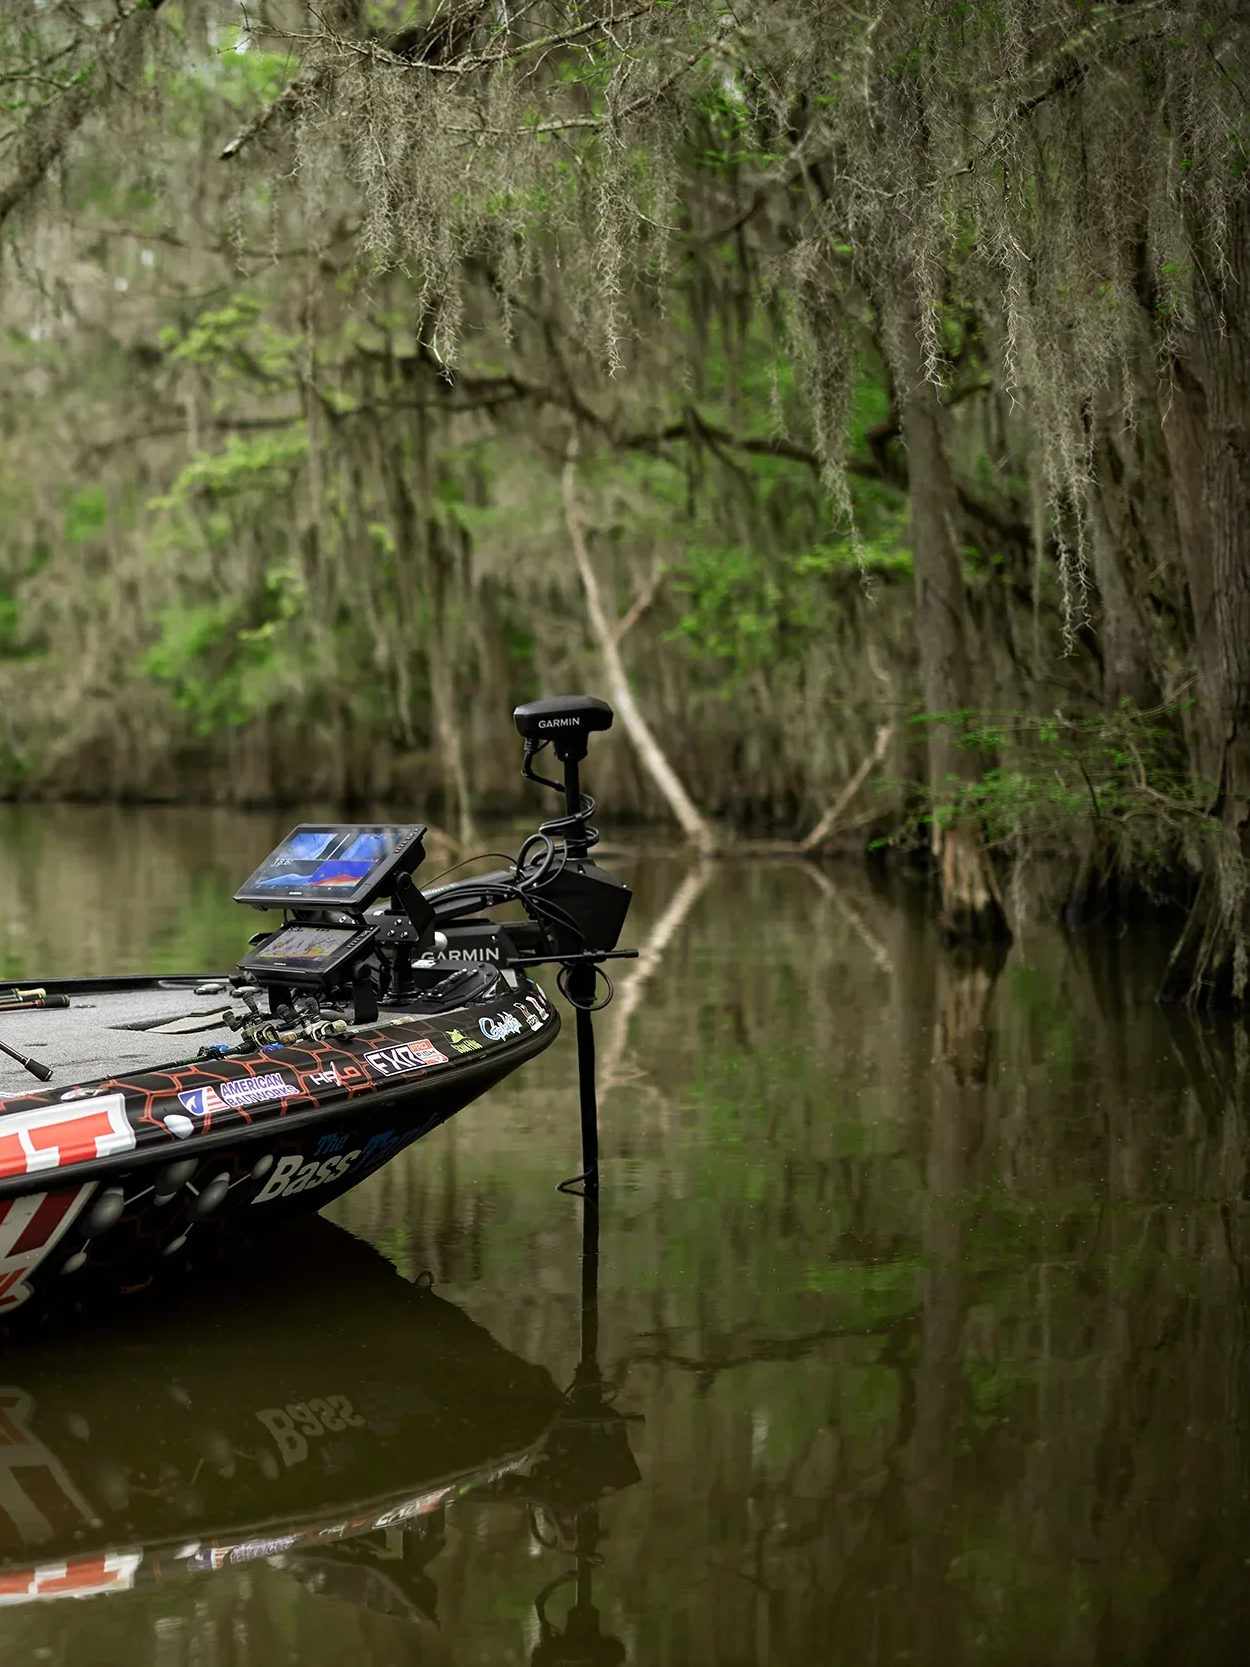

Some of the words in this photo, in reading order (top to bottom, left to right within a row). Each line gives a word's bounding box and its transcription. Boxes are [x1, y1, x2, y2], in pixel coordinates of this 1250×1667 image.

[538, 716, 580, 729] GARMIN
[421, 947, 499, 964] GARMIN
[221, 1074, 283, 1098] AMERICAN
[226, 1084, 299, 1107] BAITWORKS
[251, 1150, 362, 1204] Bass
